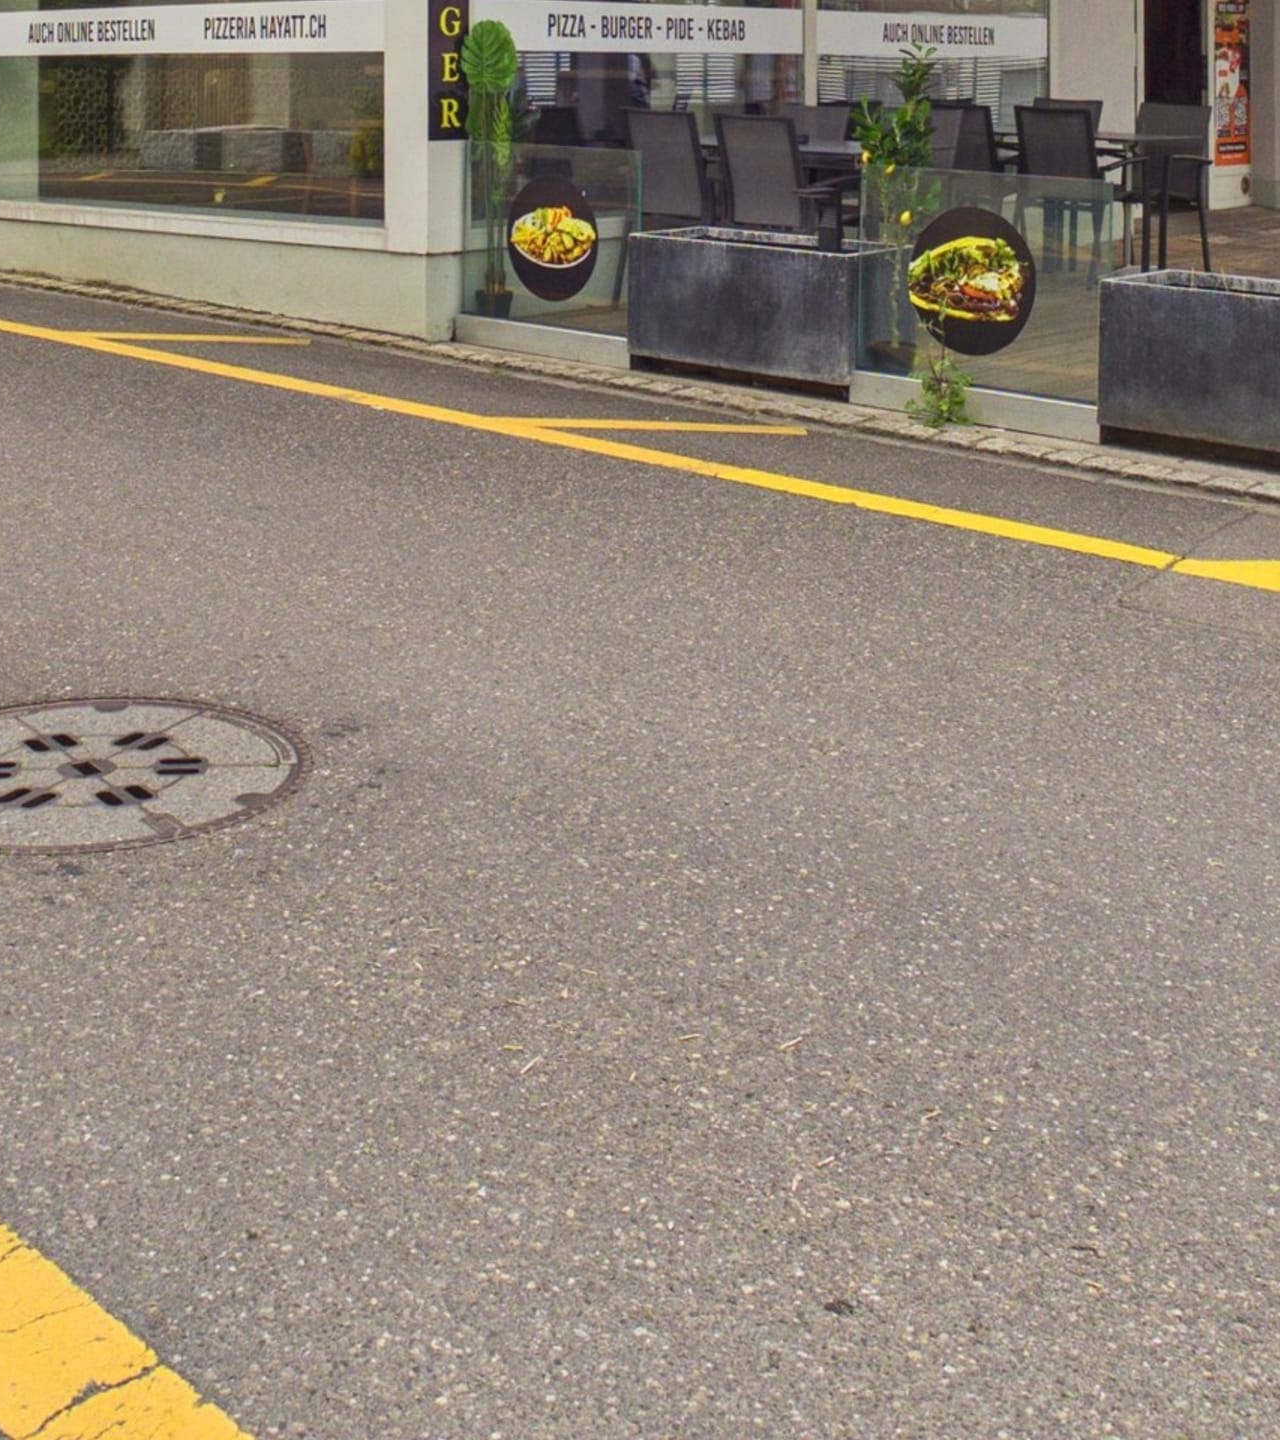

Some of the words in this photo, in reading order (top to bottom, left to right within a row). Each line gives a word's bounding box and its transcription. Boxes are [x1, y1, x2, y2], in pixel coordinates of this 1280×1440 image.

[28, 22, 54, 43] AUCH
[57, 21, 94, 43] ONLINE
[97, 19, 155, 42] BESTELLEN
[204, 17, 256, 41] PIZZERIA
[260, 14, 327, 39] HAYATT.CH
[548, 13, 586, 38] PIZZA
[601, 15, 653, 39] BURGER
[666, 17, 694, 40] PIDE
[707, 18, 746, 41] KEBAB
[882, 23, 908, 43] AUCH
[911, 24, 945, 44] ONLINE
[947, 25, 995, 46] BESTELLEN
